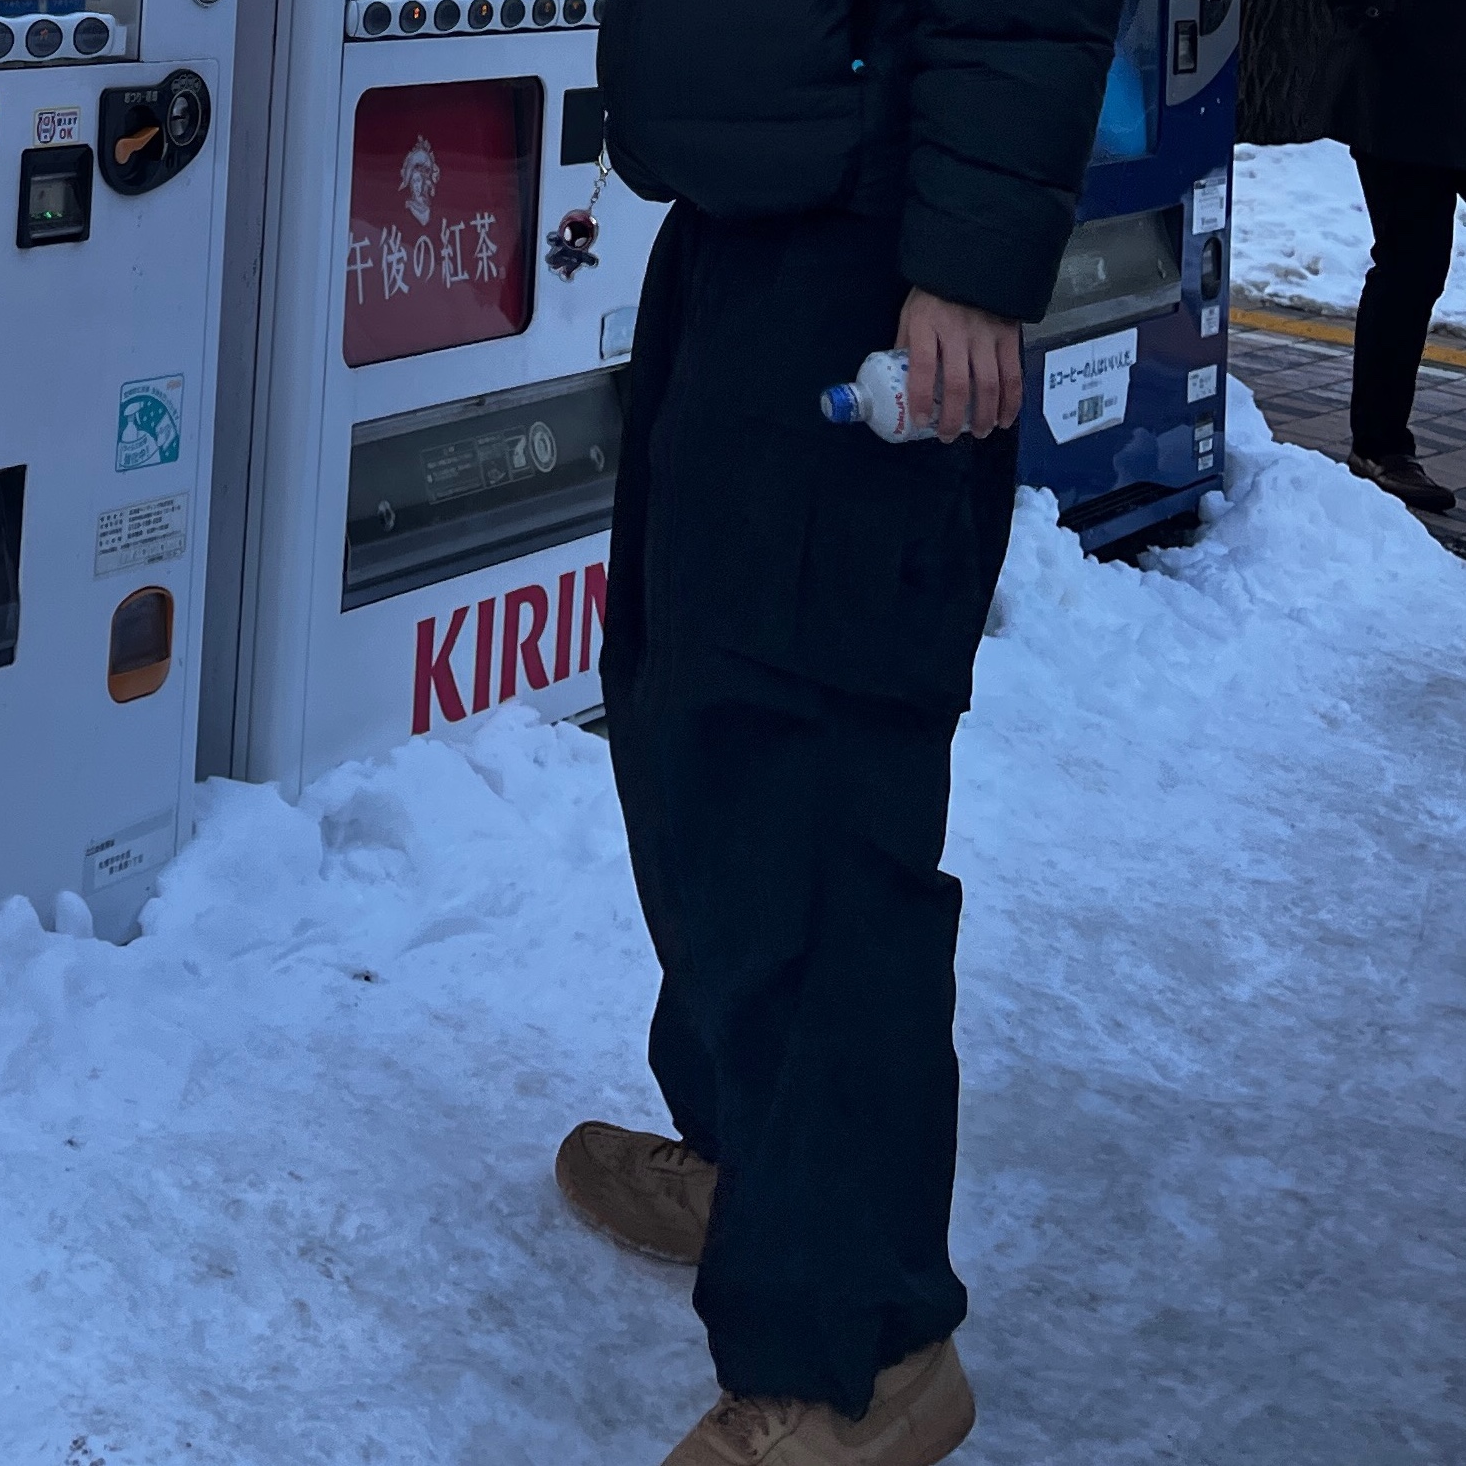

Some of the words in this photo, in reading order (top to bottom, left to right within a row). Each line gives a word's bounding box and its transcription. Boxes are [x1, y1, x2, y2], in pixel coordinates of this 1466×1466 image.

[345, 211, 500, 308] 午後の紅茶
